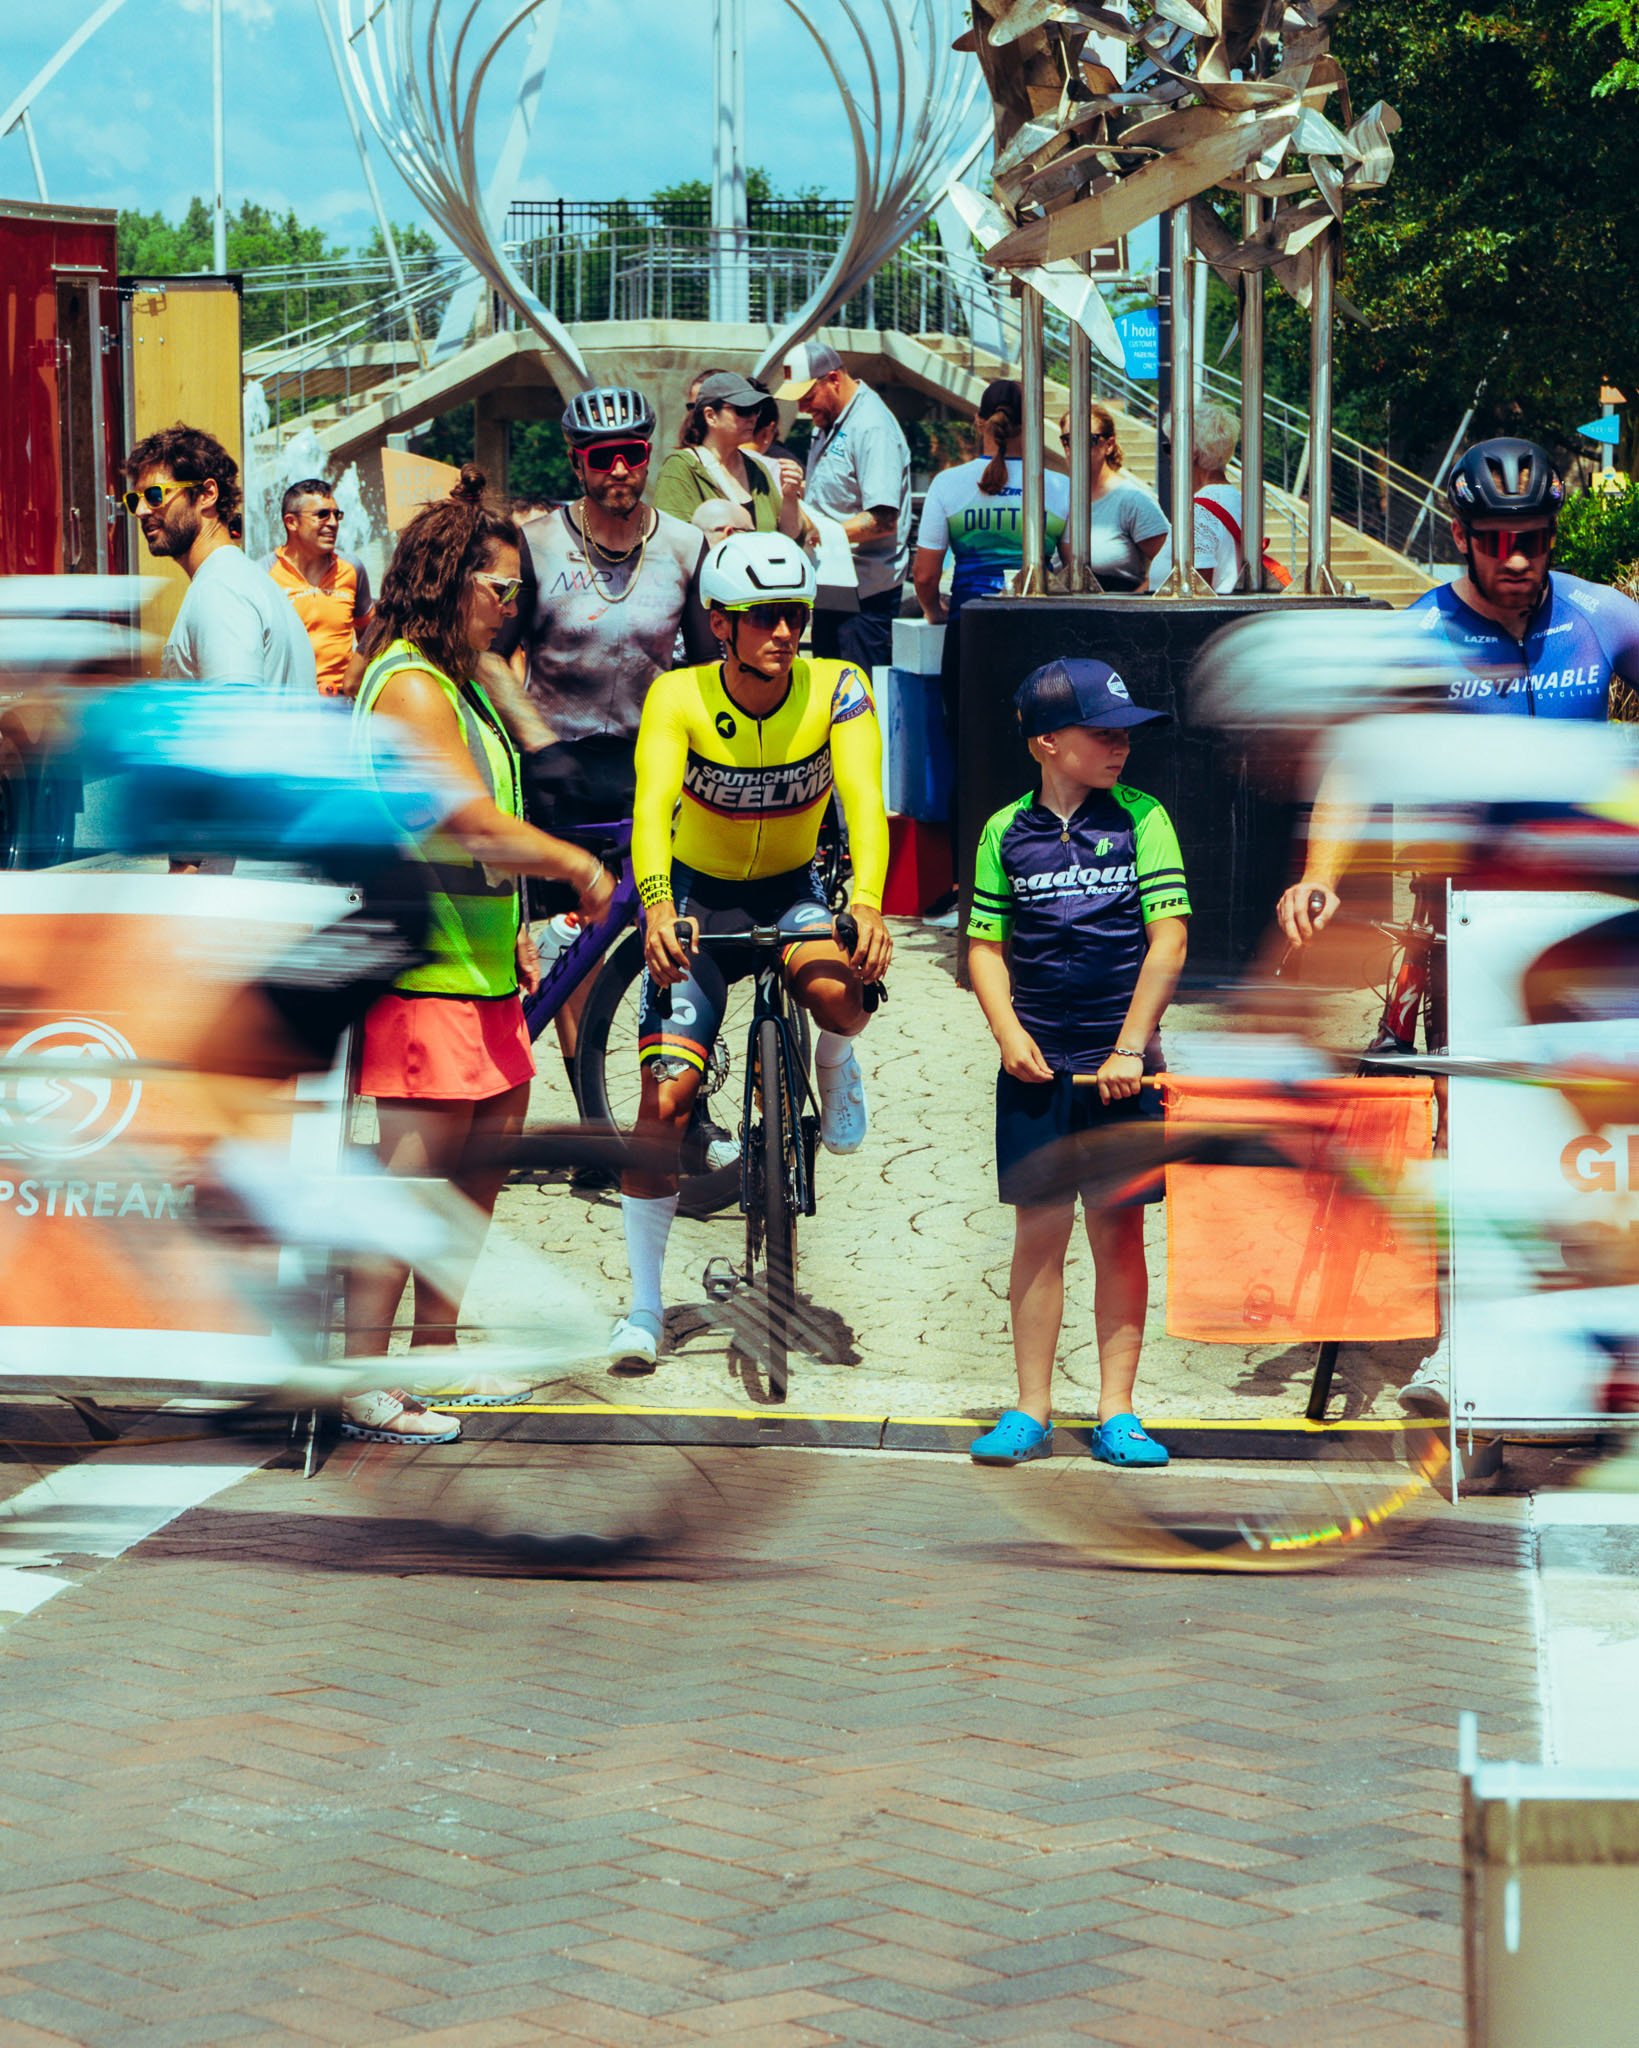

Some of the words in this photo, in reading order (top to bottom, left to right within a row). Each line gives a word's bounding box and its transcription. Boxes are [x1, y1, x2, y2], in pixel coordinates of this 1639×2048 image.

[1121, 318, 1128, 337] 1
[1131, 323, 1157, 337] hour
[1463, 634, 1499, 644] LAZER
[1447, 664, 1600, 701] SUSTAINABLE
[1537, 687, 1601, 700] CYCLING
[702, 764, 760, 787] SOUTH
[761, 748, 830, 785] CHICAGO
[684, 760, 833, 809] WHEELME
